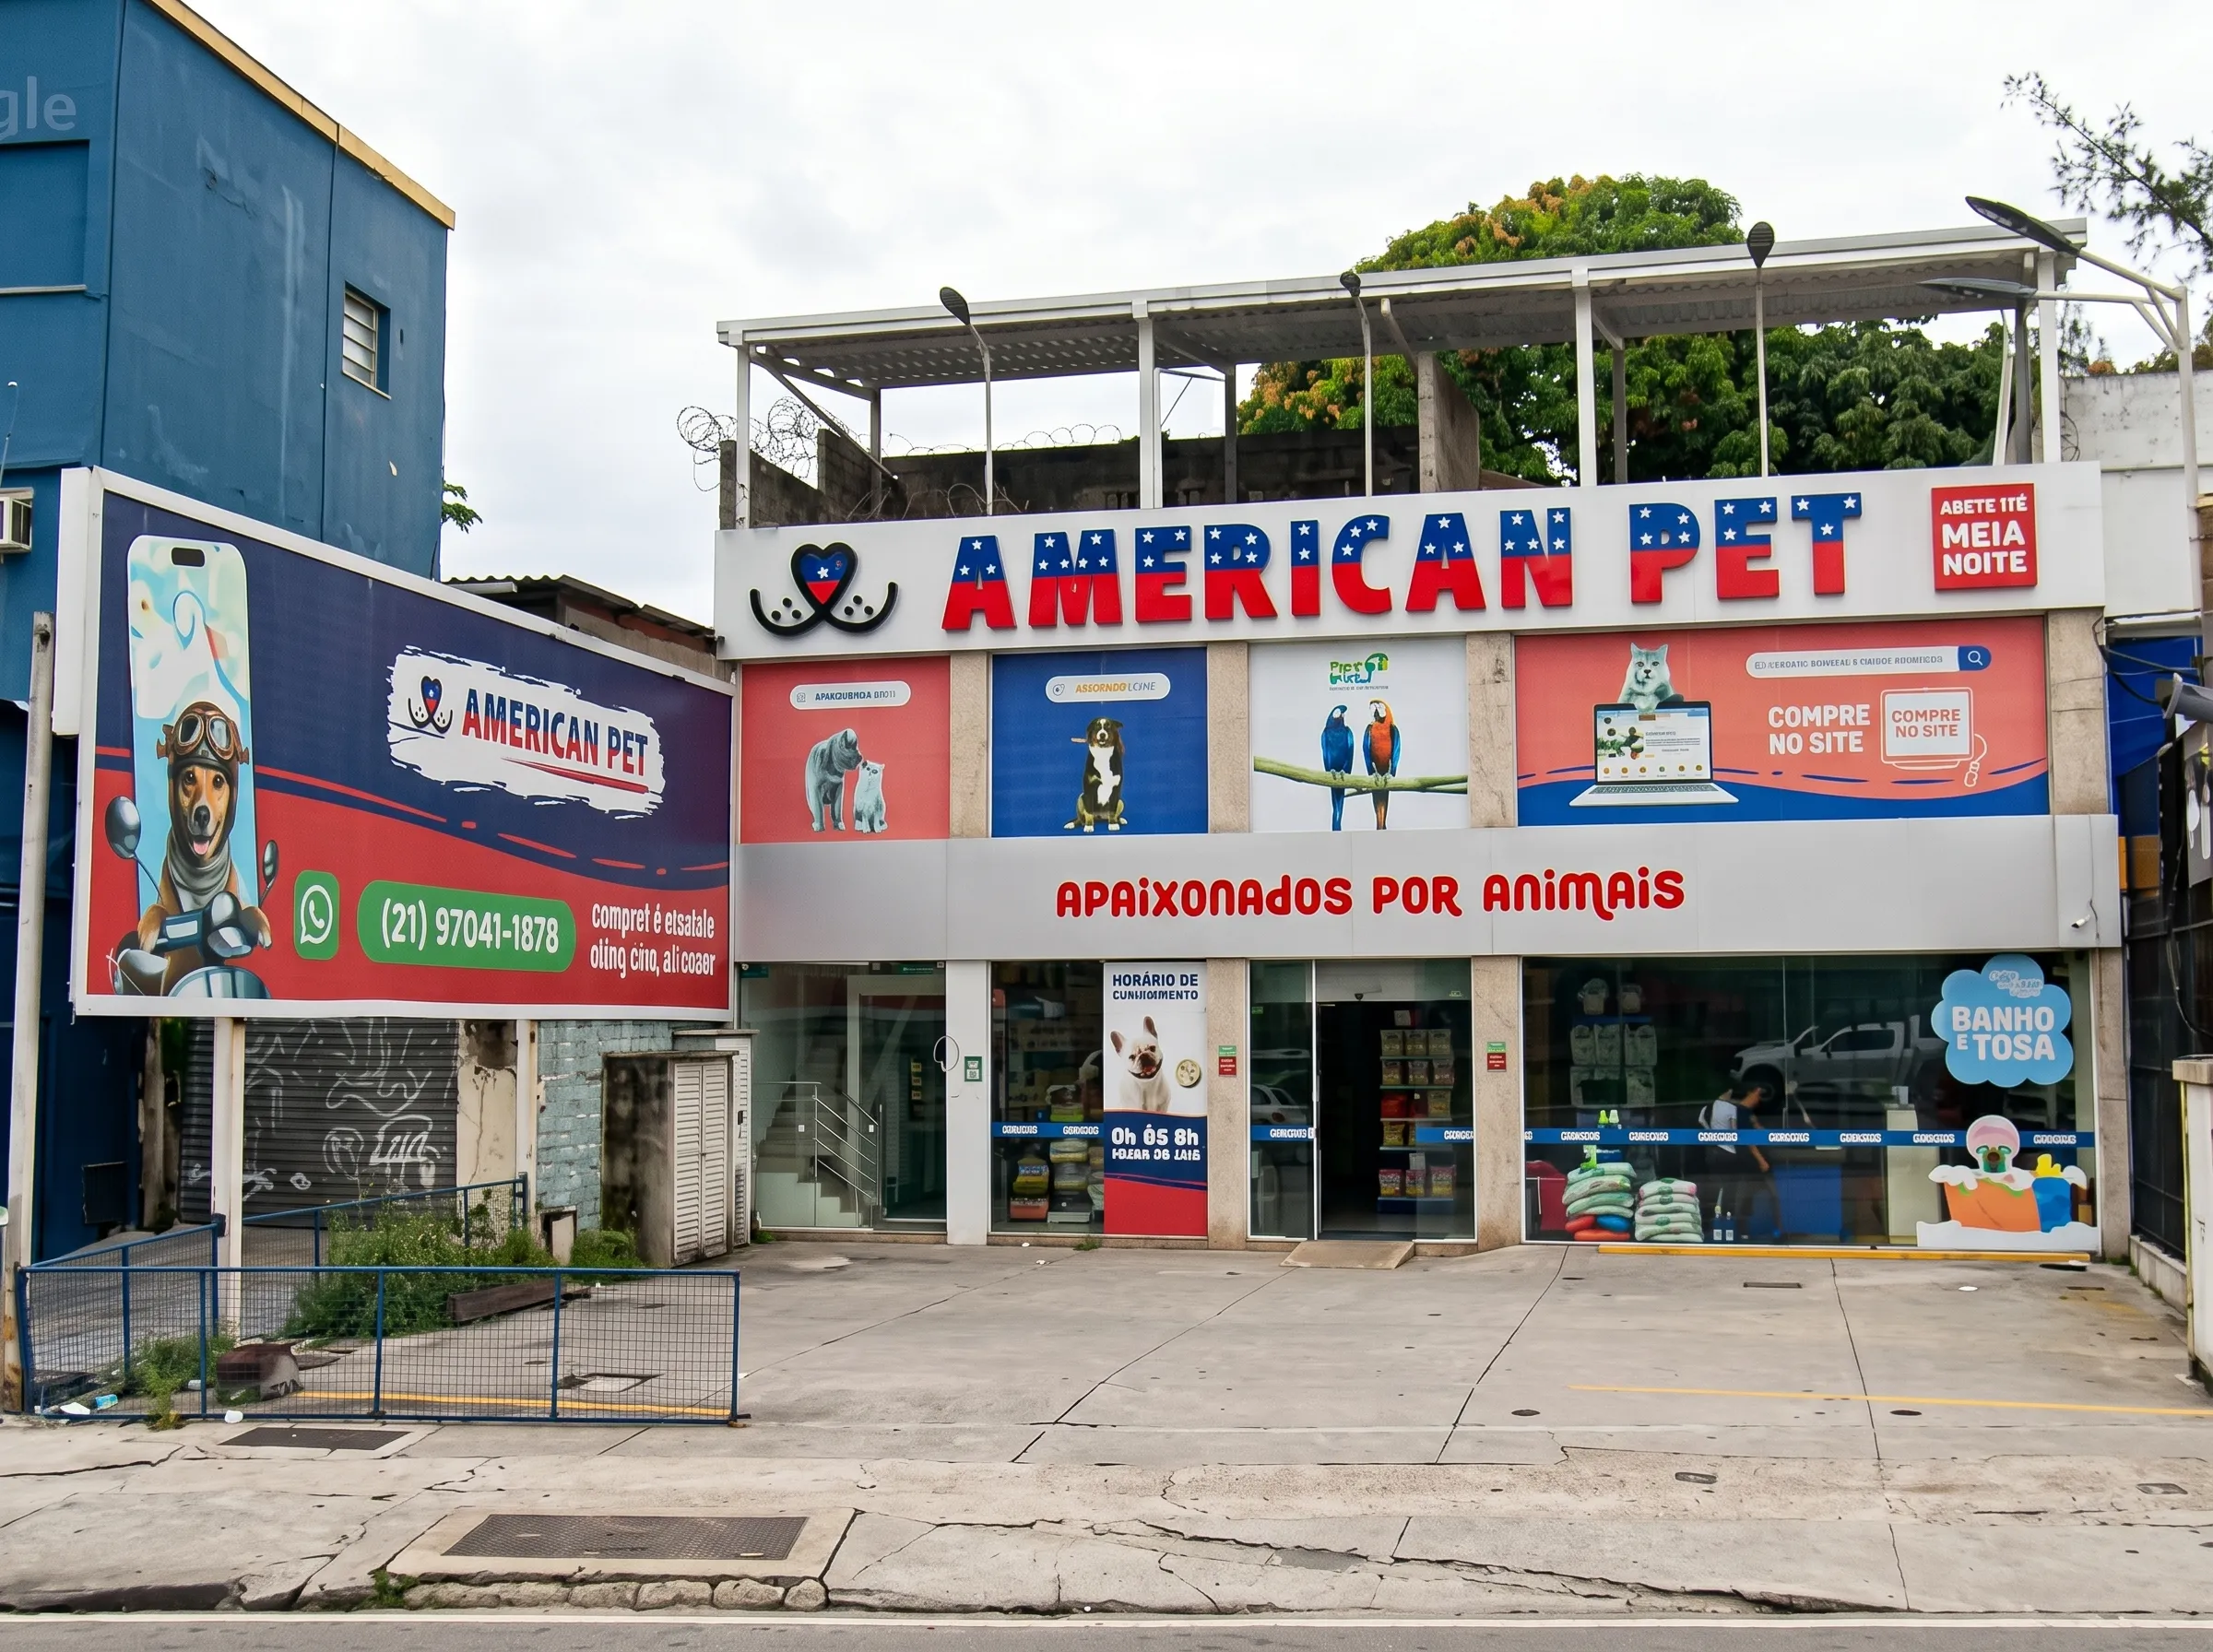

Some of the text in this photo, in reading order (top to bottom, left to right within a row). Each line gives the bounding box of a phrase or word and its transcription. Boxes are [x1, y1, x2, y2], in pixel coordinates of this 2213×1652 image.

[1940, 498, 1996, 515] ABETE
[1942, 520, 2026, 549] MEIA
[941, 491, 1863, 632] AMERICAN PET
[1943, 550, 2028, 576] NOITE
[1768, 703, 1871, 728] COMPRE
[1891, 708, 1961, 724] COMPRE
[461, 688, 648, 777] AMERICAN PET
[1769, 730, 1864, 755] NO SITE
[1895, 724, 1959, 738] NO SITE
[1372, 874, 1463, 918] POR
[382, 897, 559, 954] (21) 97041-1878
[1112, 971, 1199, 986] HORÁRIO DE
[1951, 1006, 2055, 1032] BANHO
[1957, 1033, 2056, 1061] E TOSA
[1174, 1127, 1200, 1146] 8h
